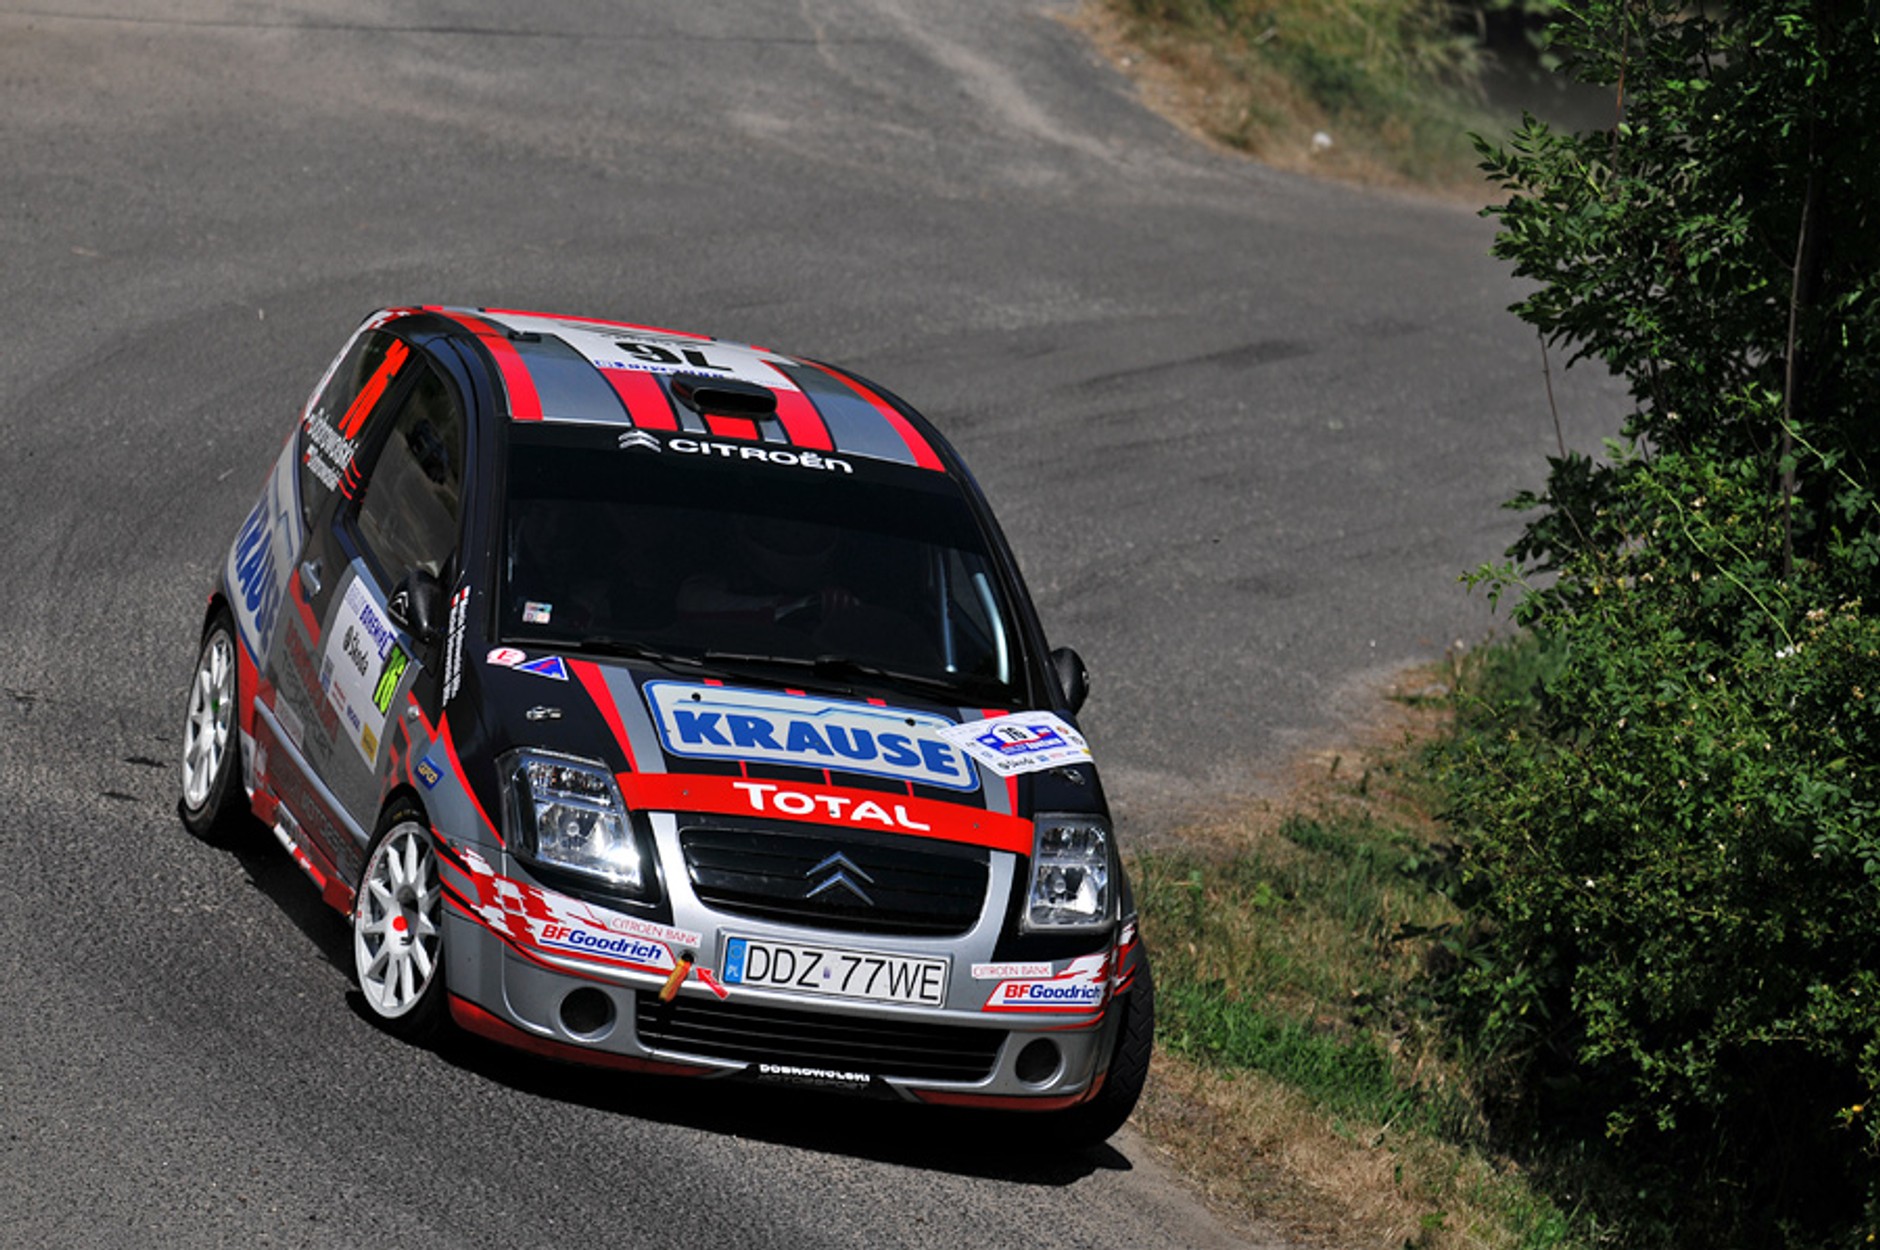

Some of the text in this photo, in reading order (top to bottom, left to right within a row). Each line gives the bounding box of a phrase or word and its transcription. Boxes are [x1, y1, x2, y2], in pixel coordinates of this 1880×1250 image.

[338, 338, 410, 439] 16
[672, 710, 961, 777] KRAUSE
[733, 781, 931, 832] TOTAL
[541, 924, 662, 960] BFGoodrich
[746, 945, 942, 1001] DDZ 77WE
[1004, 984, 1101, 999] BFGoodrich
